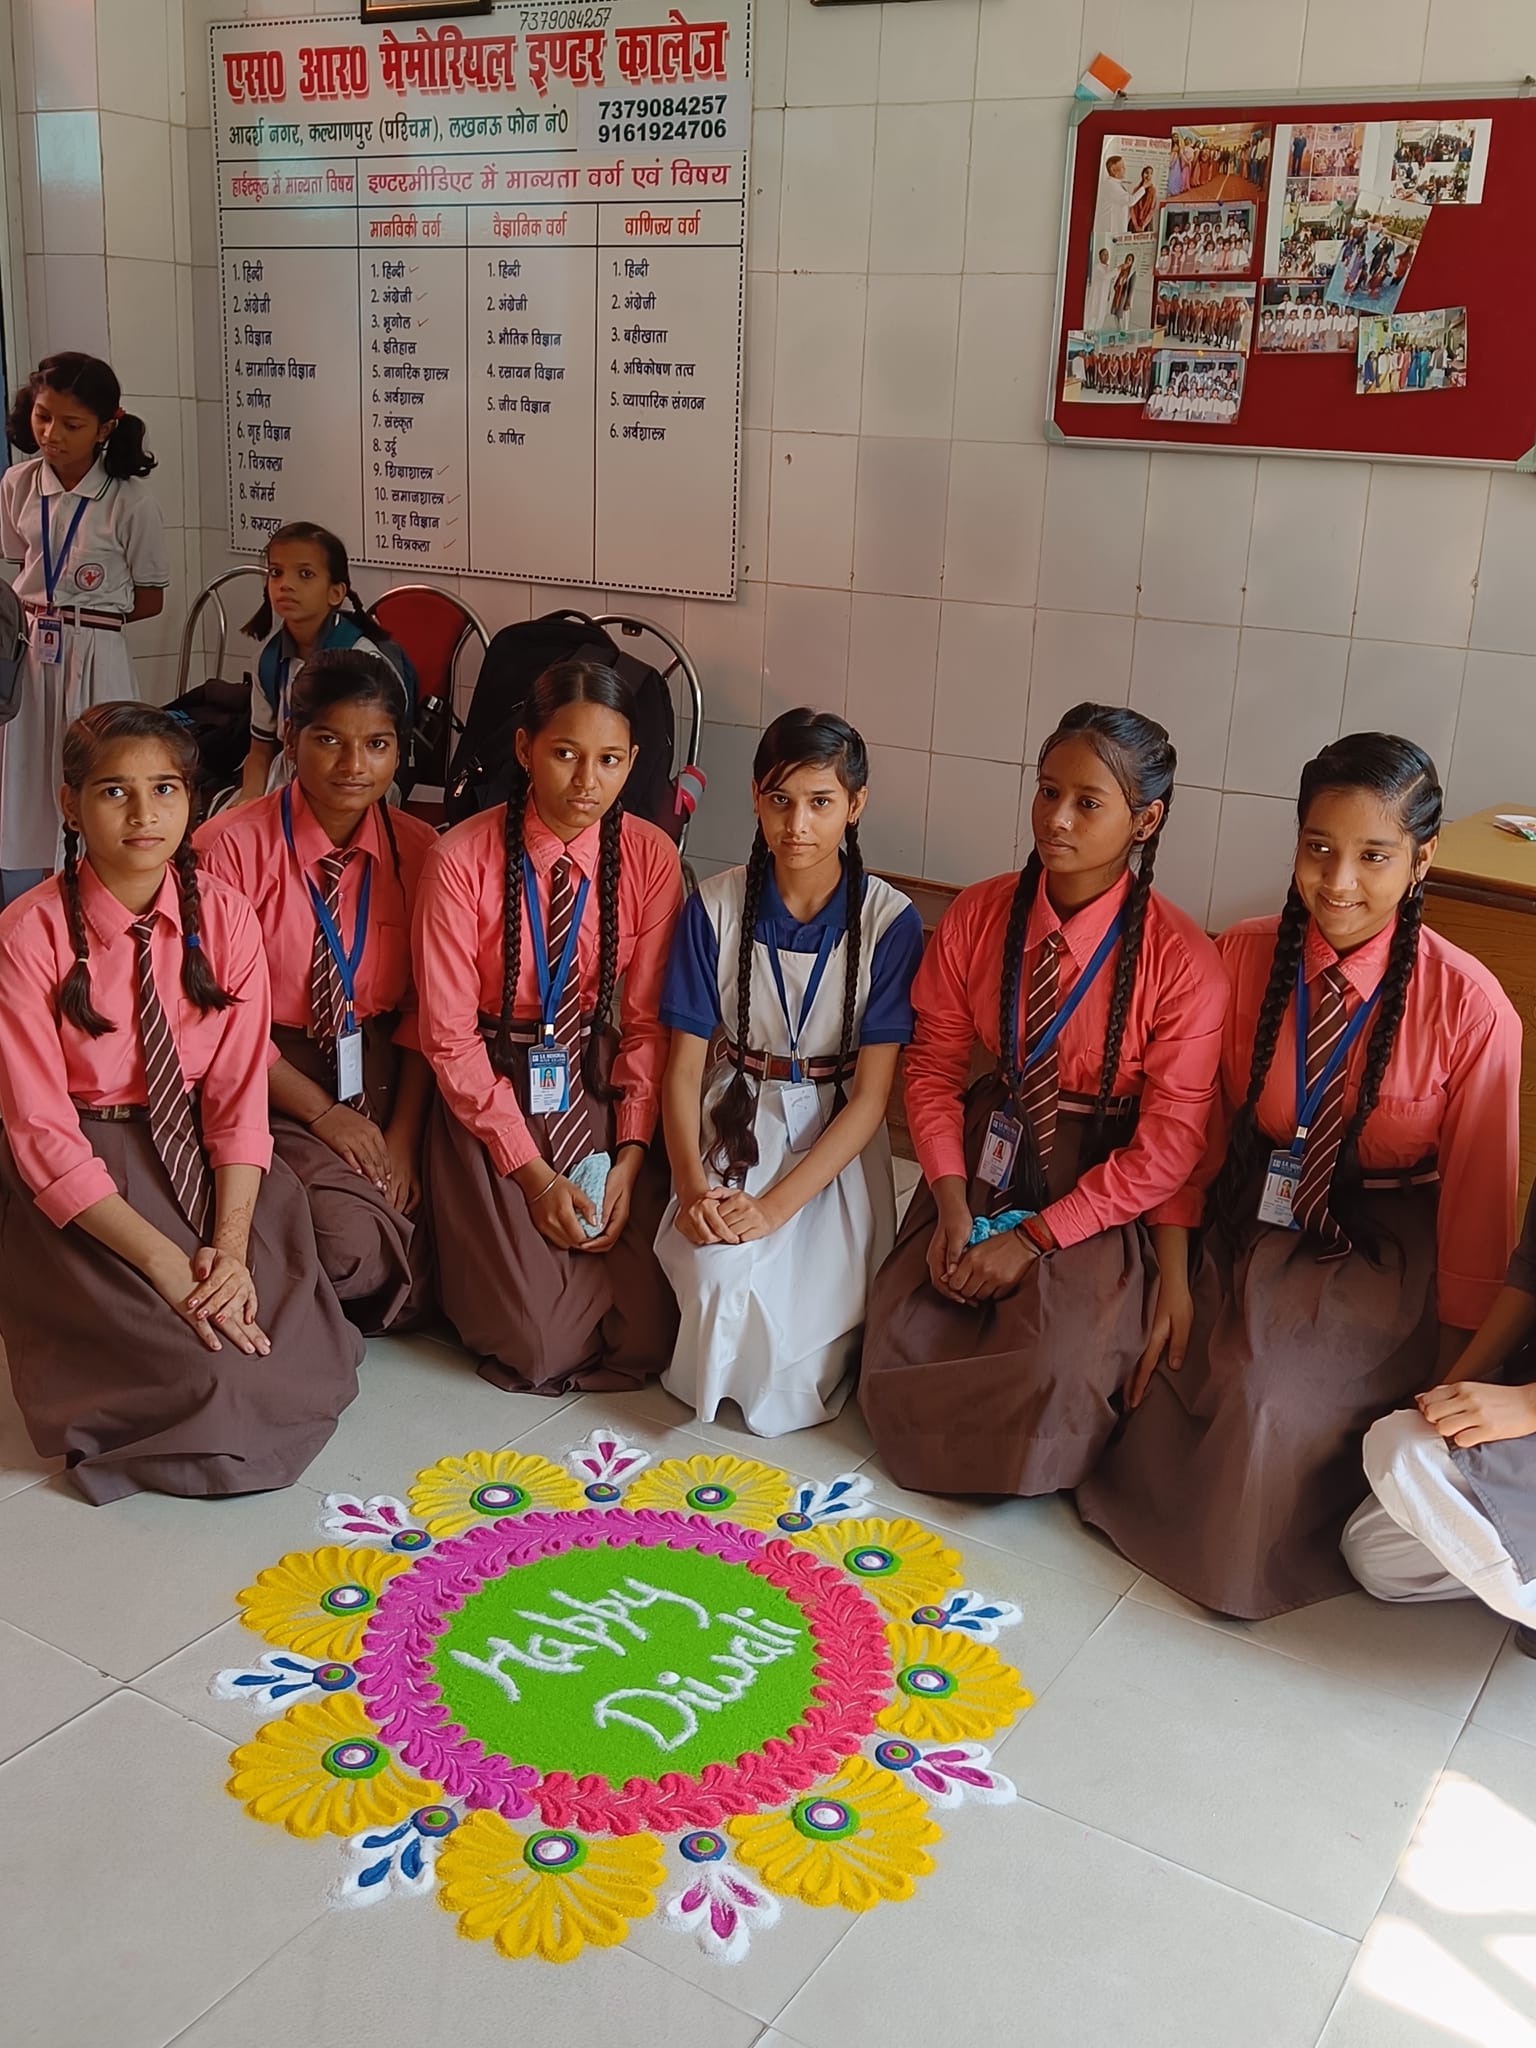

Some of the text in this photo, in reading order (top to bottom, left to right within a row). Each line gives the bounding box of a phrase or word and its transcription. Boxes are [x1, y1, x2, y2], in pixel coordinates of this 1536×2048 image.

[520, 7, 612, 31] 7379084257
[379, 24, 517, 90] मेमोरियल
[525, 29, 607, 92] इण्टर
[615, 9, 729, 80] कालेज
[599, 94, 727, 120] 7379084257
[229, 117, 264, 147] आदर्श
[268, 123, 304, 146] नगर,
[308, 120, 373, 149] कल्याणपुर
[449, 116, 502, 139] लखनऊ
[507, 107, 539, 135] फोन
[599, 119, 727, 143] 9161924706
[285, 174, 323, 195] मान्यता
[326, 168, 355, 193] विषय
[368, 158, 731, 194] इण्टरमीडिएट में मान्यता वर्ग एवं विषय
[369, 213, 442, 239] मानविकी वर्ग
[493, 211, 568, 239] वैज्ञानिक वर्ग
[625, 209, 701, 236] वाणिज्य वर्ग
[232, 260, 263, 282] 1. हिन्दी
[371, 260, 406, 279] 1. हिन्दी
[487, 259, 521, 278] 1. हिन्दी
[613, 258, 649, 278] 1. हिन्दी
[244, 291, 271, 314] अंग्रेजी
[371, 285, 413, 304] 2. अंग्रेजी
[487, 293, 528, 312] 2. अंग्रेजी
[612, 291, 657, 311] 2. अंग्रेजी
[371, 312, 411, 333] 3. भूगोल
[234, 324, 272, 346] 3. विज्ञान
[487, 327, 561, 347] 3. भौतिक विज्ञान
[611, 324, 668, 344] 3. बहीखाता
[371, 337, 417, 355] 4. इतिहास
[235, 359, 243, 376] 4.
[288, 357, 317, 380] विज्ञान
[372, 362, 449, 381] 5. नागरिक शास्त्र
[487, 362, 565, 381] 4. रसायन विज्ञान
[610, 359, 620, 374] 4.
[236, 388, 271, 408] 5. गणित
[372, 387, 424, 405] 6. अर्थशास्त्र
[487, 394, 551, 414] 5. जीव विज्ञान
[610, 390, 706, 411] 5. व्यापारिक संगठन
[237, 420, 291, 445] 6. गृह विज्ञान
[373, 411, 414, 434] 7. संस्कृत
[610, 421, 666, 441] 6. अर्थशास्त्र
[373, 436, 397, 457] 8. उर्दू
[487, 428, 525, 446] 6. गणित
[238, 449, 284, 471] 7. चित्रकला
[373, 462, 382, 476] 9.
[240, 481, 275, 502] 8. कॉमर्स
[374, 487, 445, 505] 10. समाजशास्त्र
[241, 513, 248, 530] 9.
[375, 511, 440, 530] 11. गृह विज्ञान
[392, 534, 431, 553] चित्रकला
[593, 1606, 802, 1753] Diwali
